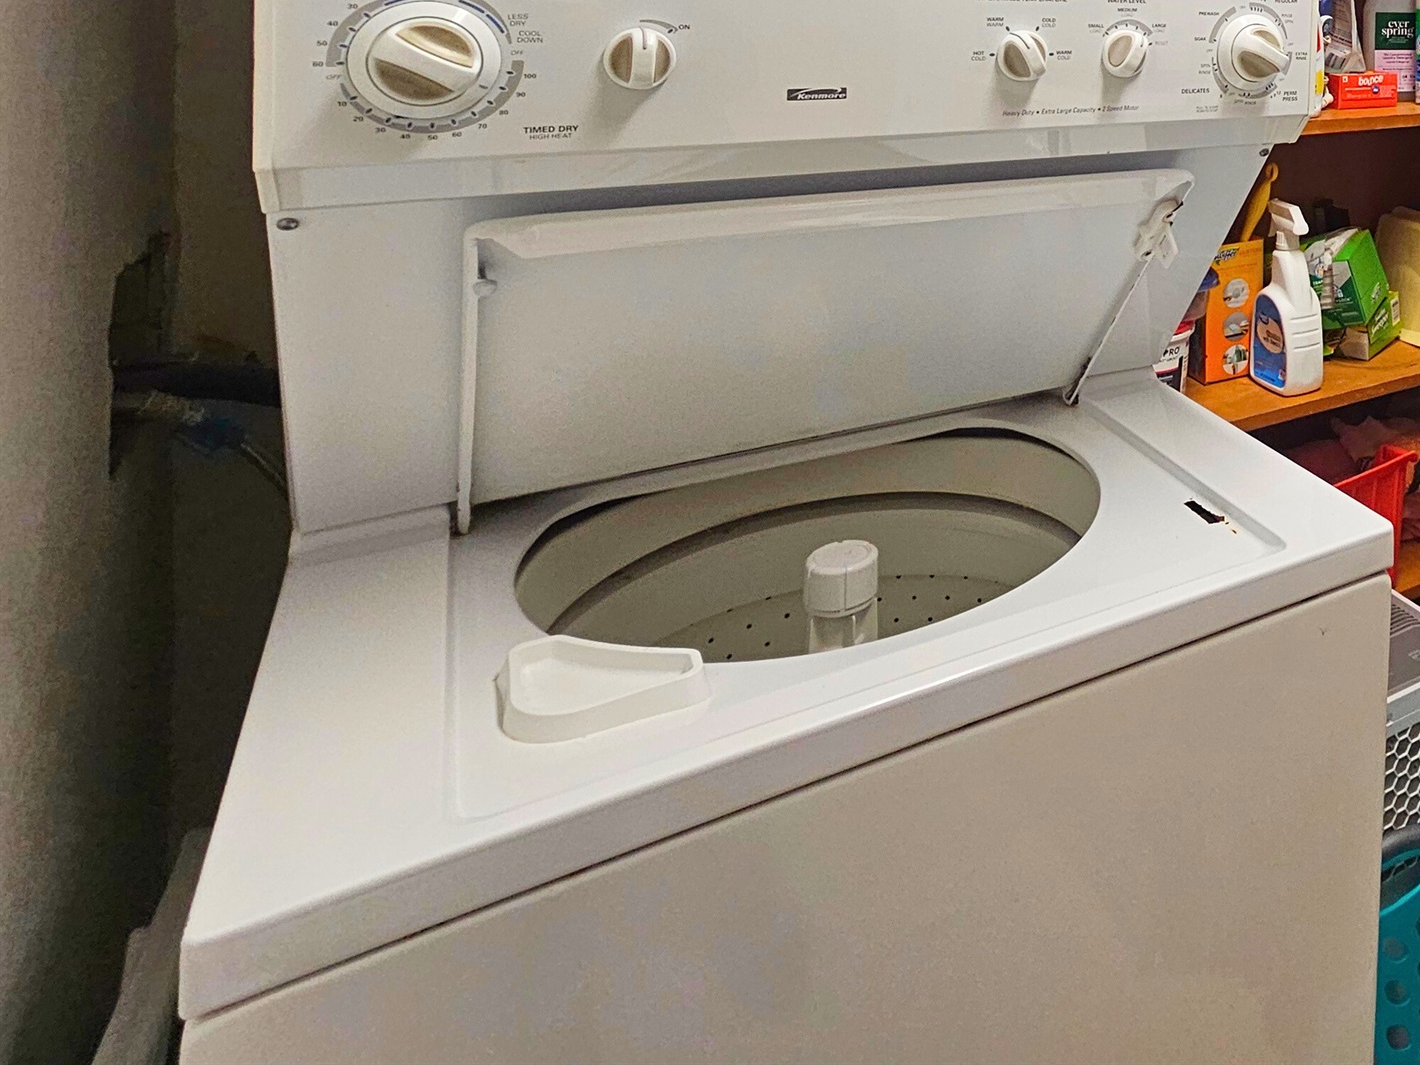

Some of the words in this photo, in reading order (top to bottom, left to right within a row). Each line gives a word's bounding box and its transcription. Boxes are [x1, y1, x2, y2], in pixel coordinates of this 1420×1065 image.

[1387, 20, 1410, 28] ever
[1381, 26, 1415, 39] spring
[1358, 74, 1385, 87] bounce
[797, 91, 847, 101] Kenmore
[1002, 110, 1021, 118] Heavy
[1021, 109, 1035, 117] Duty
[1056, 107, 1072, 116] Large
[1072, 106, 1097, 114] Capacity
[523, 126, 556, 135] TIMED
[558, 125, 579, 133] DRY
